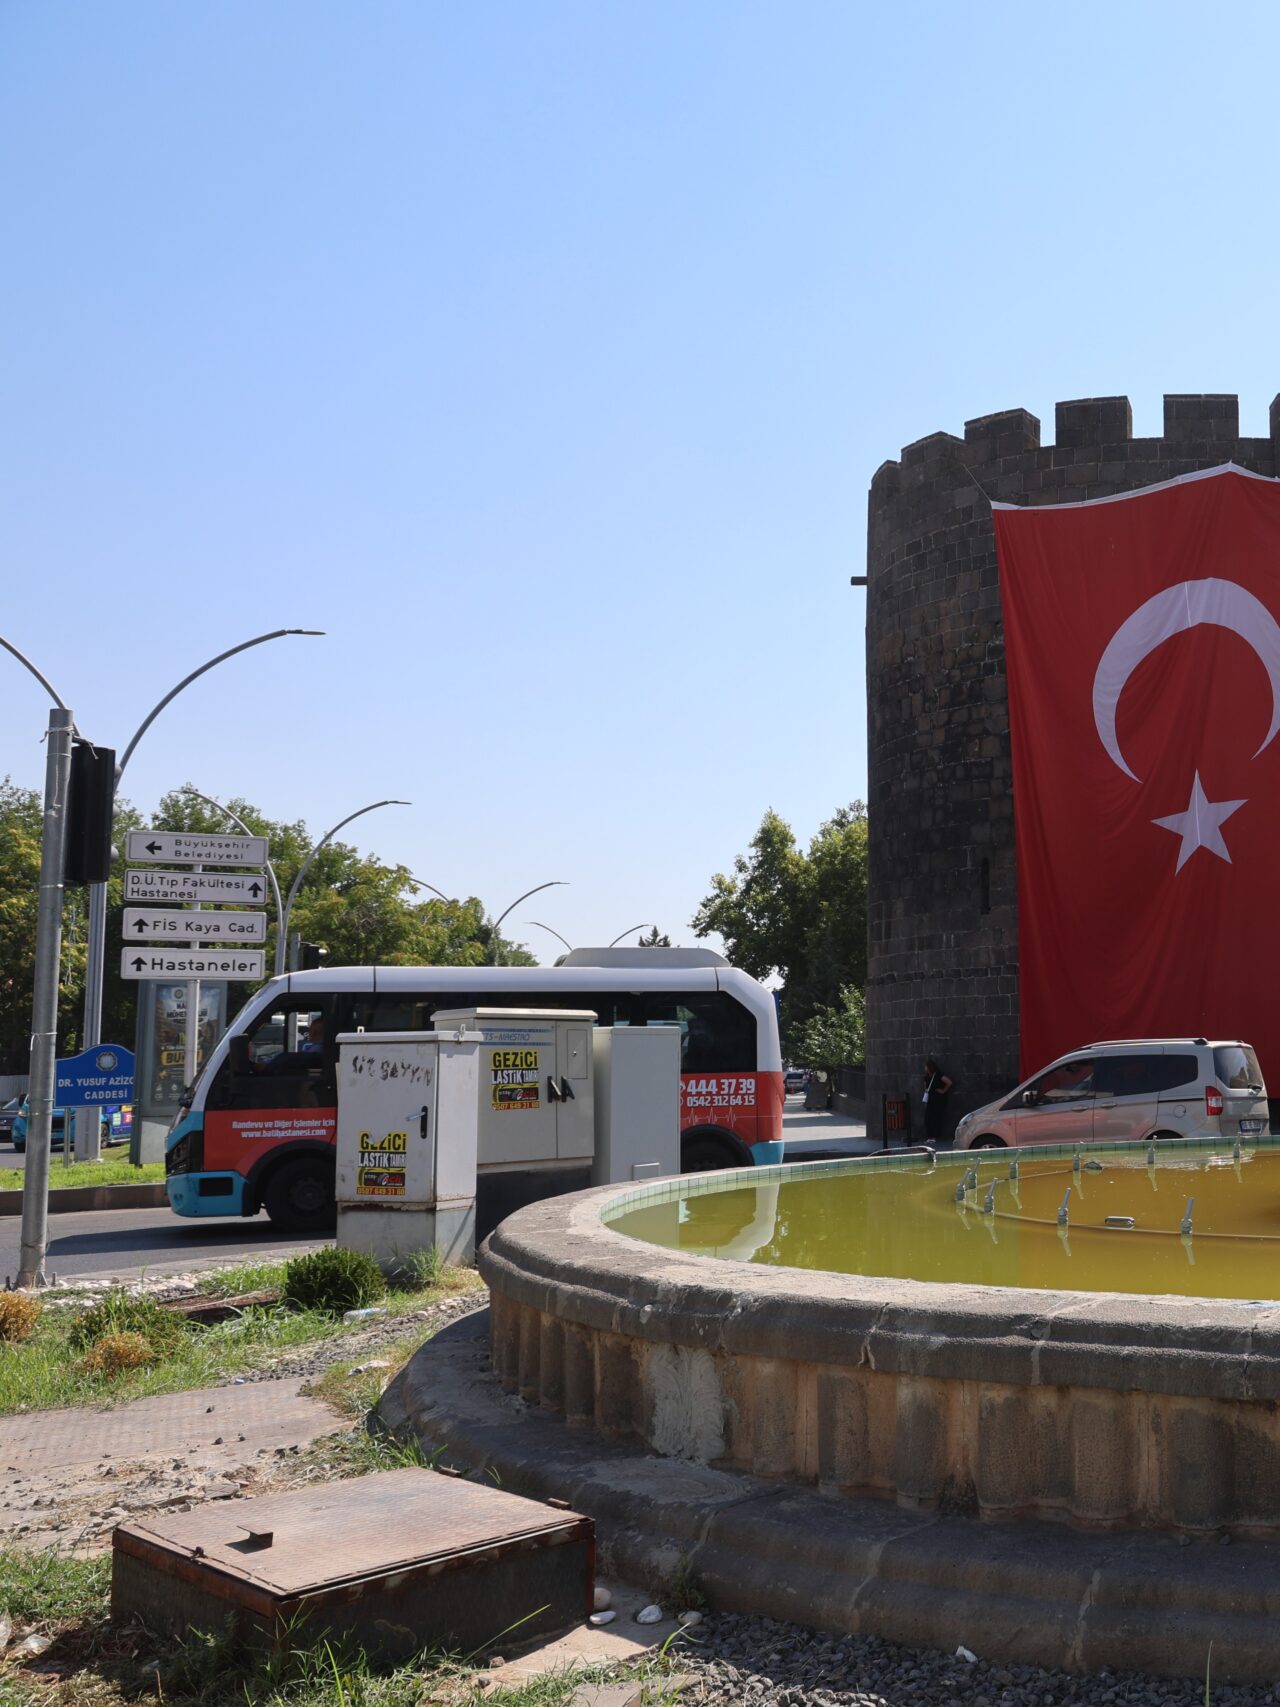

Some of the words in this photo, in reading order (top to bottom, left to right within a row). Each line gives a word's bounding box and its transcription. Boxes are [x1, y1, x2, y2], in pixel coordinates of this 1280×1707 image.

[174, 838, 251, 850] Büyükşehir
[174, 850, 244, 861] Belediyesi
[183, 877, 245, 889] Fakültesi
[131, 887, 197, 899] Hastanesi
[152, 918, 177, 931] FİS
[185, 921, 221, 935] Kaya
[228, 922, 258, 934] Cad.
[151, 957, 257, 972] Hastaneler
[58, 1078, 74, 1087] DR.
[77, 1077, 107, 1086] YUSUF
[687, 1079, 718, 1095] 444
[720, 1079, 736, 1094] 37
[738, 1078, 756, 1094] 39
[84, 1089, 128, 1100] CADDESİ
[687, 1096, 711, 1107] 0542
[712, 1095, 729, 1106] 312
[730, 1095, 742, 1106] 64
[743, 1094, 755, 1105] 15
[232, 1121, 264, 1129] Randevu
